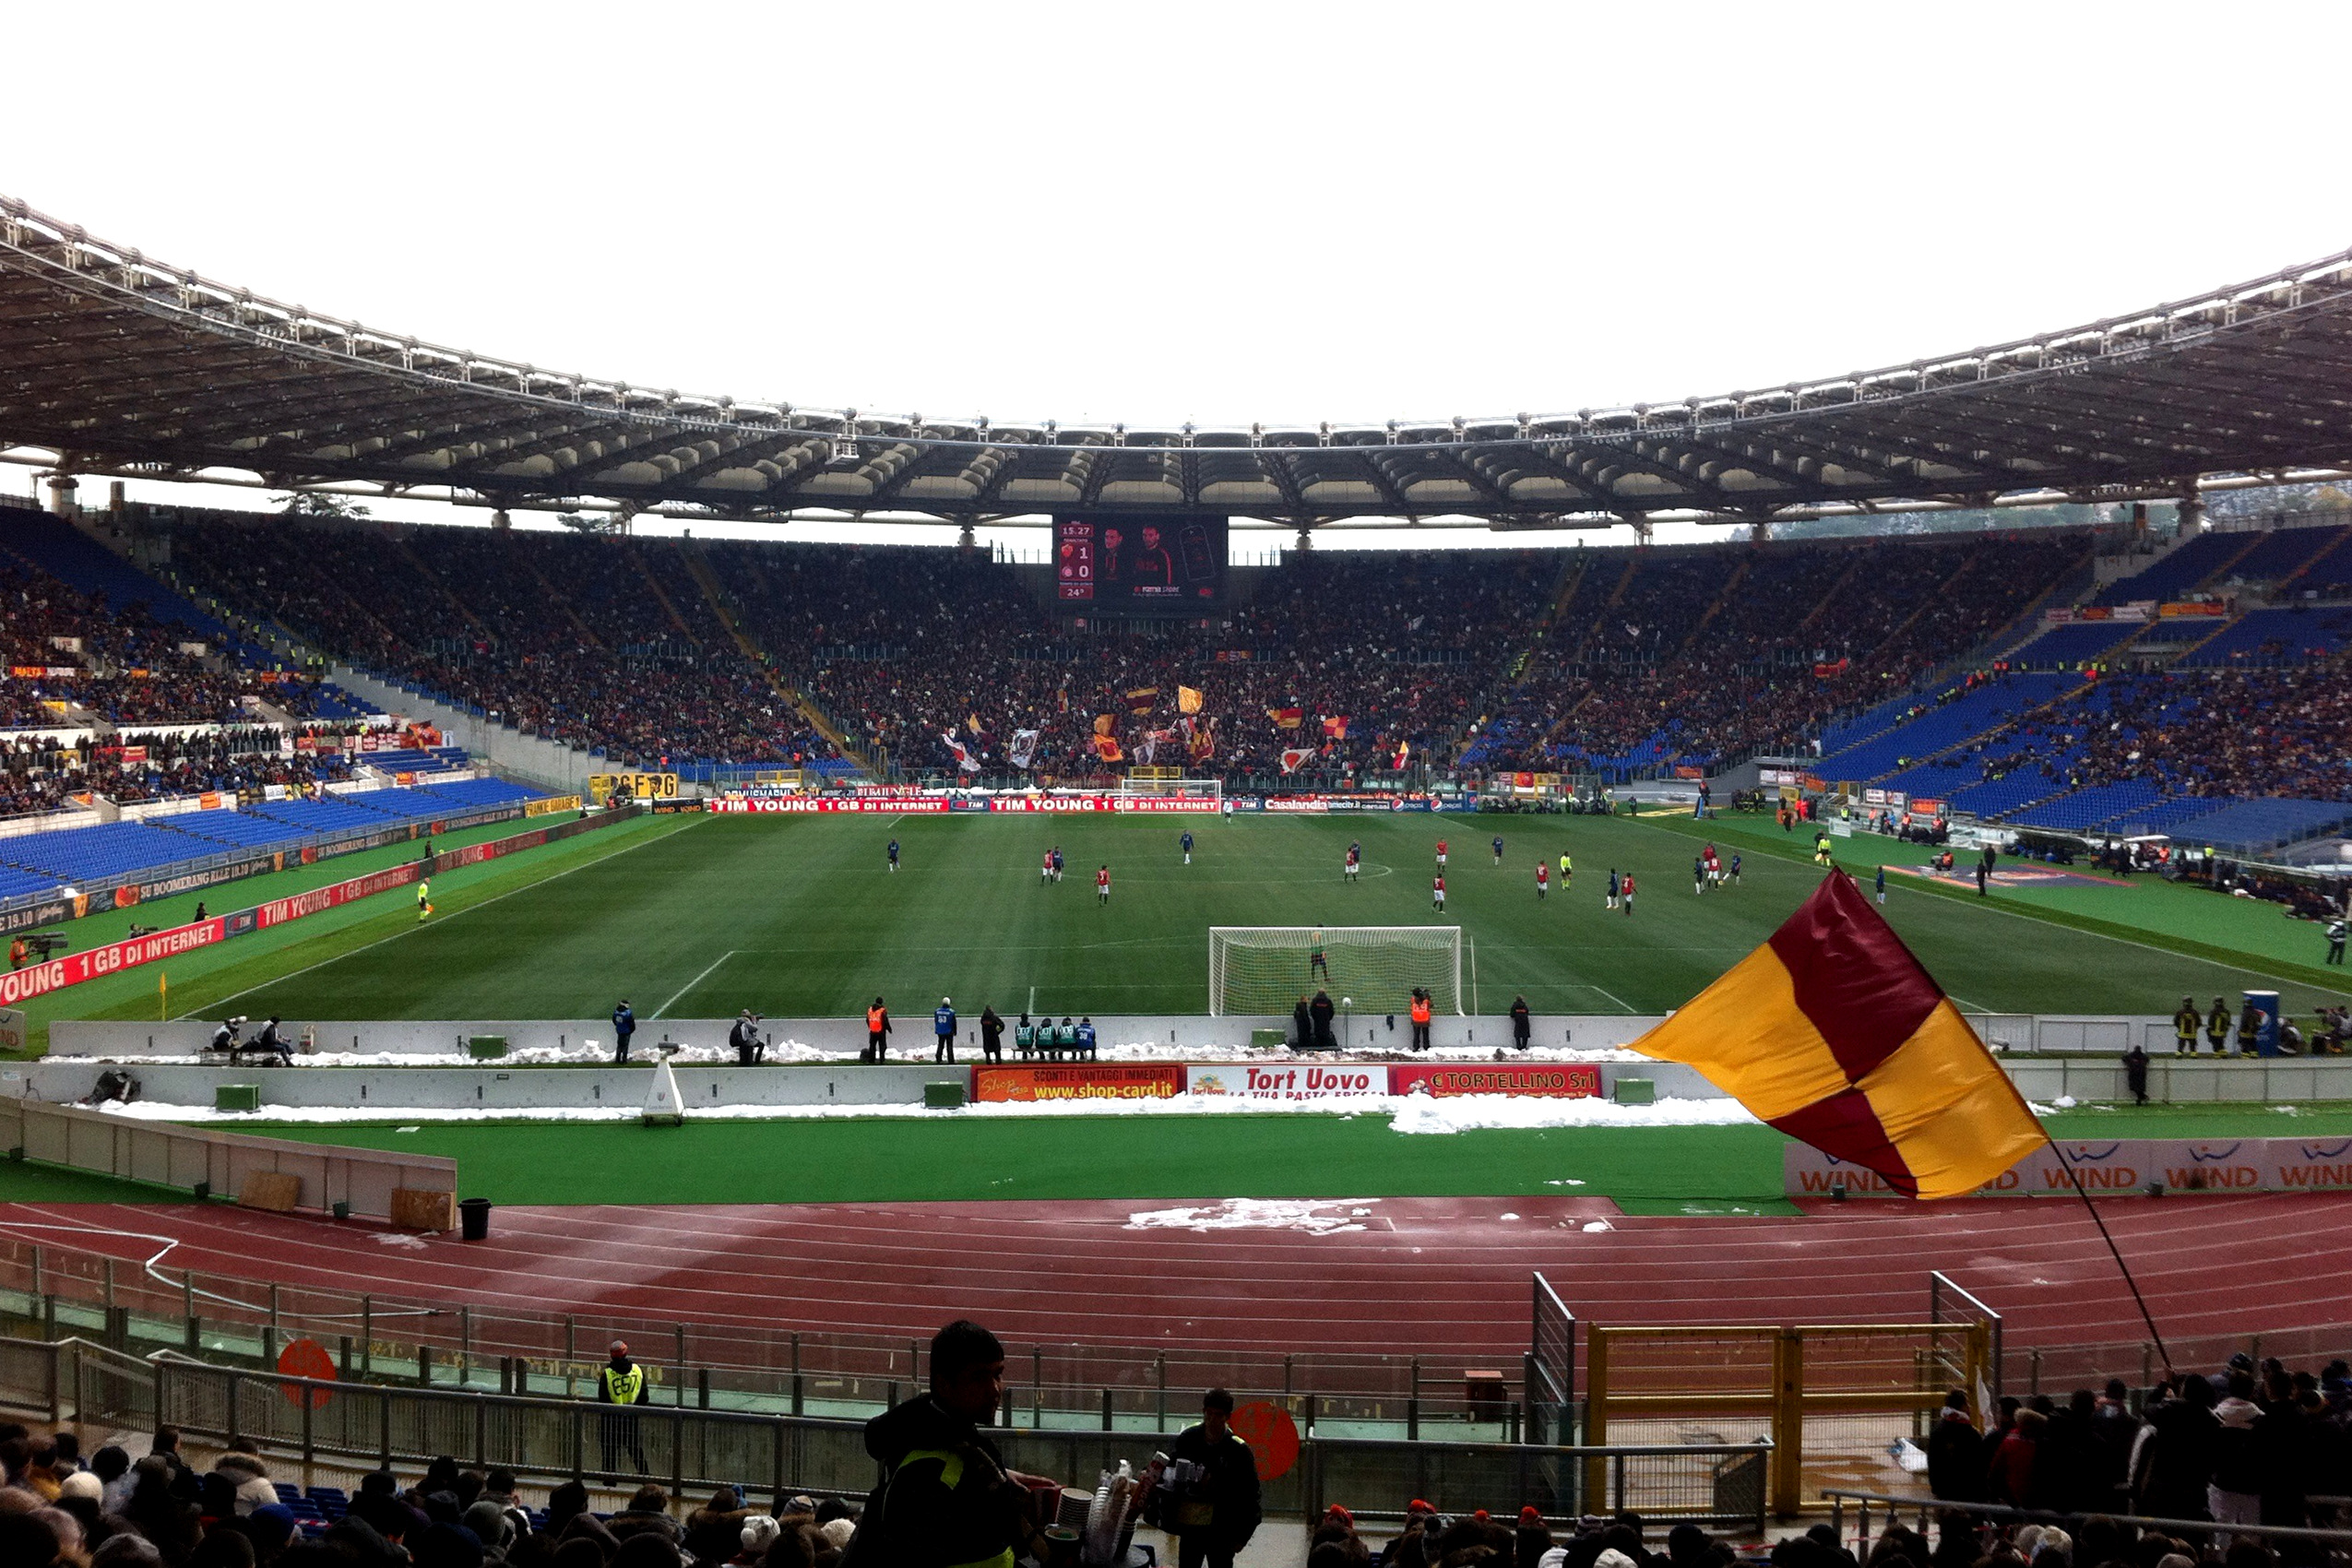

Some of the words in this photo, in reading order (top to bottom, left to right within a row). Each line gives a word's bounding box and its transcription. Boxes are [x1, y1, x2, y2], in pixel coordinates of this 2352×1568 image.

[1079, 547, 1088, 559] 1
[1078, 565, 1089, 577] 0
[718, 801, 749, 812] TIM
[753, 801, 819, 811] YOUNG
[826, 802, 833, 811] 1
[837, 802, 860, 811] GB
[880, 802, 943, 810] INTERNET
[993, 800, 1026, 810] TIM
[1031, 800, 1096, 810] YOUNG
[1101, 801, 1108, 810] 1
[1113, 800, 1135, 810] GB
[1153, 802, 1217, 810] INTERNET
[1264, 799, 1328, 810] Casalandia
[153, 873, 210, 897] BOOMERANG
[263, 903, 289, 926] TIM
[291, 891, 331, 919] YOUNG
[347, 881, 362, 899] GB
[80, 958, 89, 978] 1
[94, 946, 122, 974] GB
[125, 945, 142, 965] DI
[146, 923, 216, 958] INTERNET
[1033, 1070, 1068, 1082] SCONTI
[1069, 1070, 1075, 1082] E
[1077, 1070, 1123, 1082] VANTAGGI
[1124, 1068, 1173, 1081] IMMEDIATI
[1246, 1068, 1297, 1090] Tort
[1306, 1067, 1370, 1090] Uovo
[1445, 1072, 1570, 1089] TORTELLINO
[1570, 1071, 1596, 1089] Srl
[1033, 1081, 1173, 1099] www.shop-card.it
[2042, 1166, 2138, 1189] WIND
[2166, 1166, 2260, 1188] WIND
[2279, 1164, 2352, 1187] WIN
